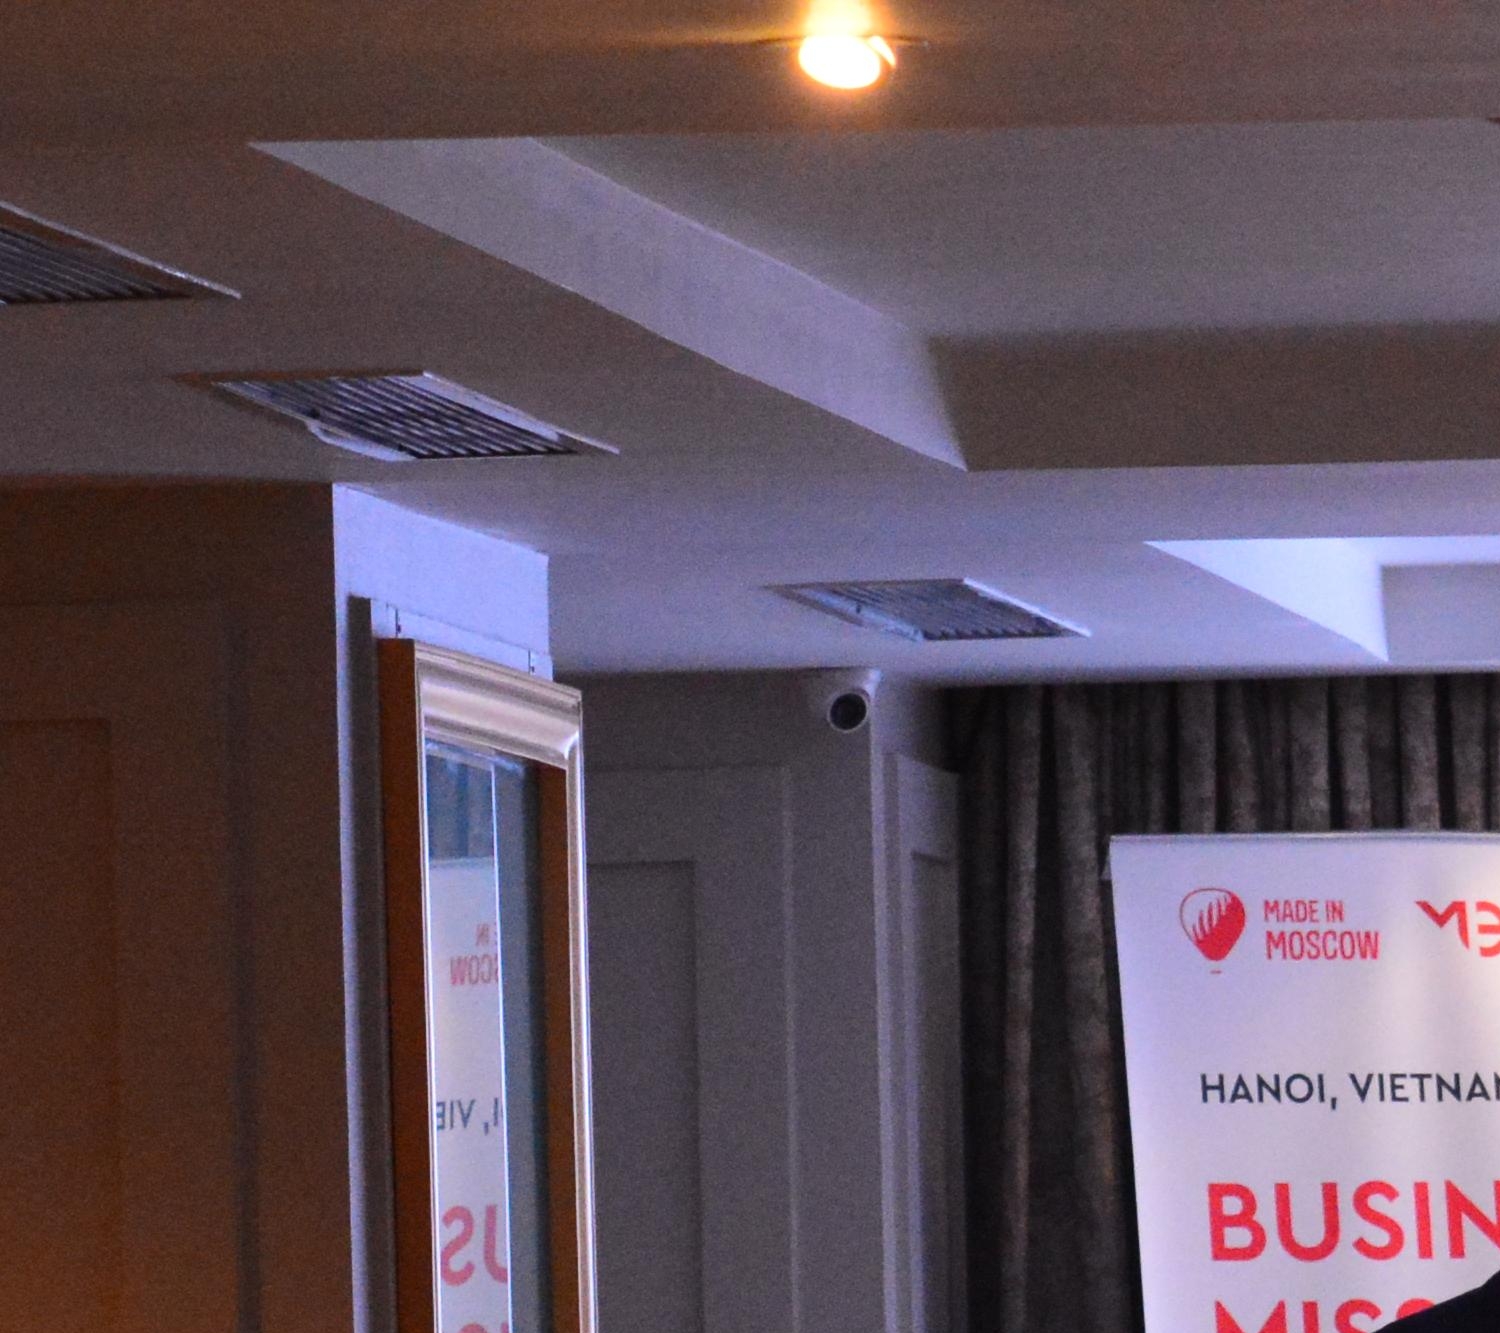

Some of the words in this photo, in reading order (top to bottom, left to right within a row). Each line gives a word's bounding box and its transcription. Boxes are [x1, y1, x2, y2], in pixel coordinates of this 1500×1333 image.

[1263, 899, 1320, 923] MADE
[1325, 899, 1345, 922] IN
[1265, 929, 1381, 961] MOSCOW
[1200, 1073, 1337, 1110] HANOI,
